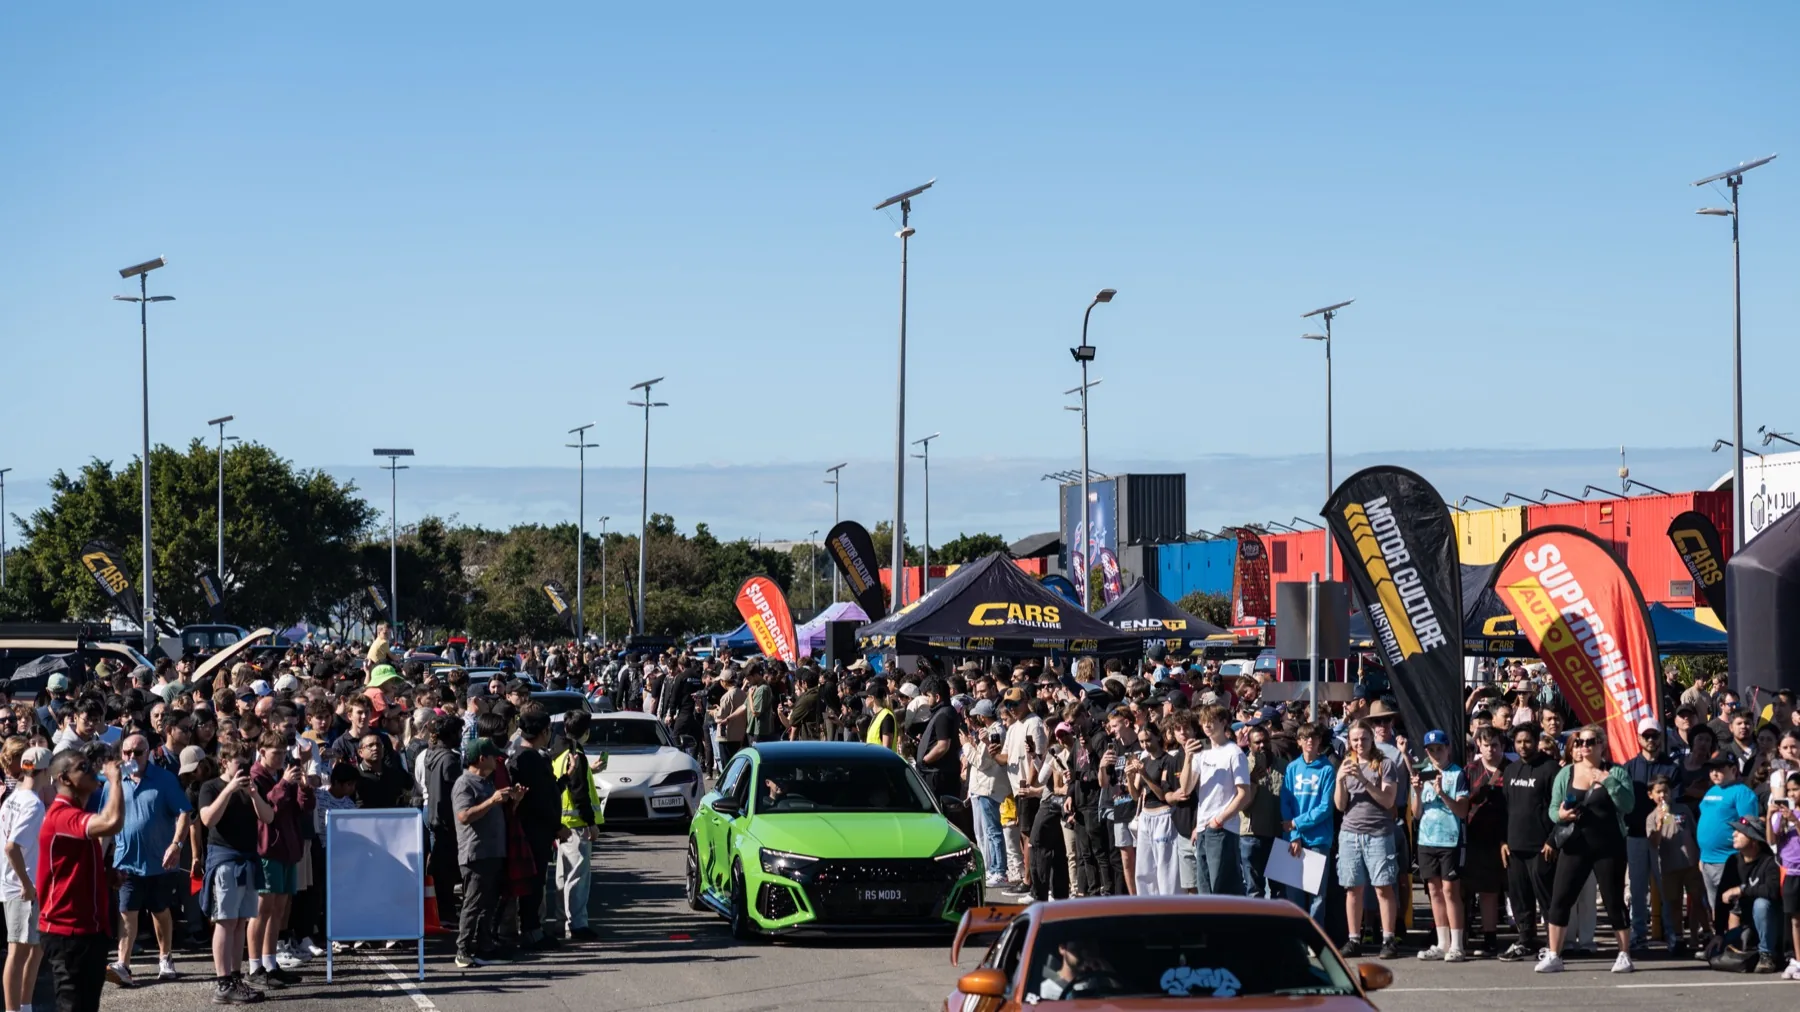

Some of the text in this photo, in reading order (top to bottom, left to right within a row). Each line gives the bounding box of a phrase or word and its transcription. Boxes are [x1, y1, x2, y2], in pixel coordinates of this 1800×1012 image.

[82, 551, 129, 593] CARS
[838, 532, 856, 563] MOTOR
[853, 556, 875, 592] CULTURE
[1363, 496, 1447, 653] MOTOR CULTURE
[1672, 529, 1723, 586] CARS
[753, 620, 773, 650] AUTO
[968, 602, 1060, 626] CARS
[1018, 620, 1062, 630] CULTURE
[1368, 602, 1404, 667] AUSTRALIA
[1519, 588, 1563, 645] AUTO
[966, 636, 995, 650] CARS
[1070, 638, 1098, 651] CARS
[1564, 655, 1606, 711] CLUB
[865, 890, 901, 900] RS MOD3
